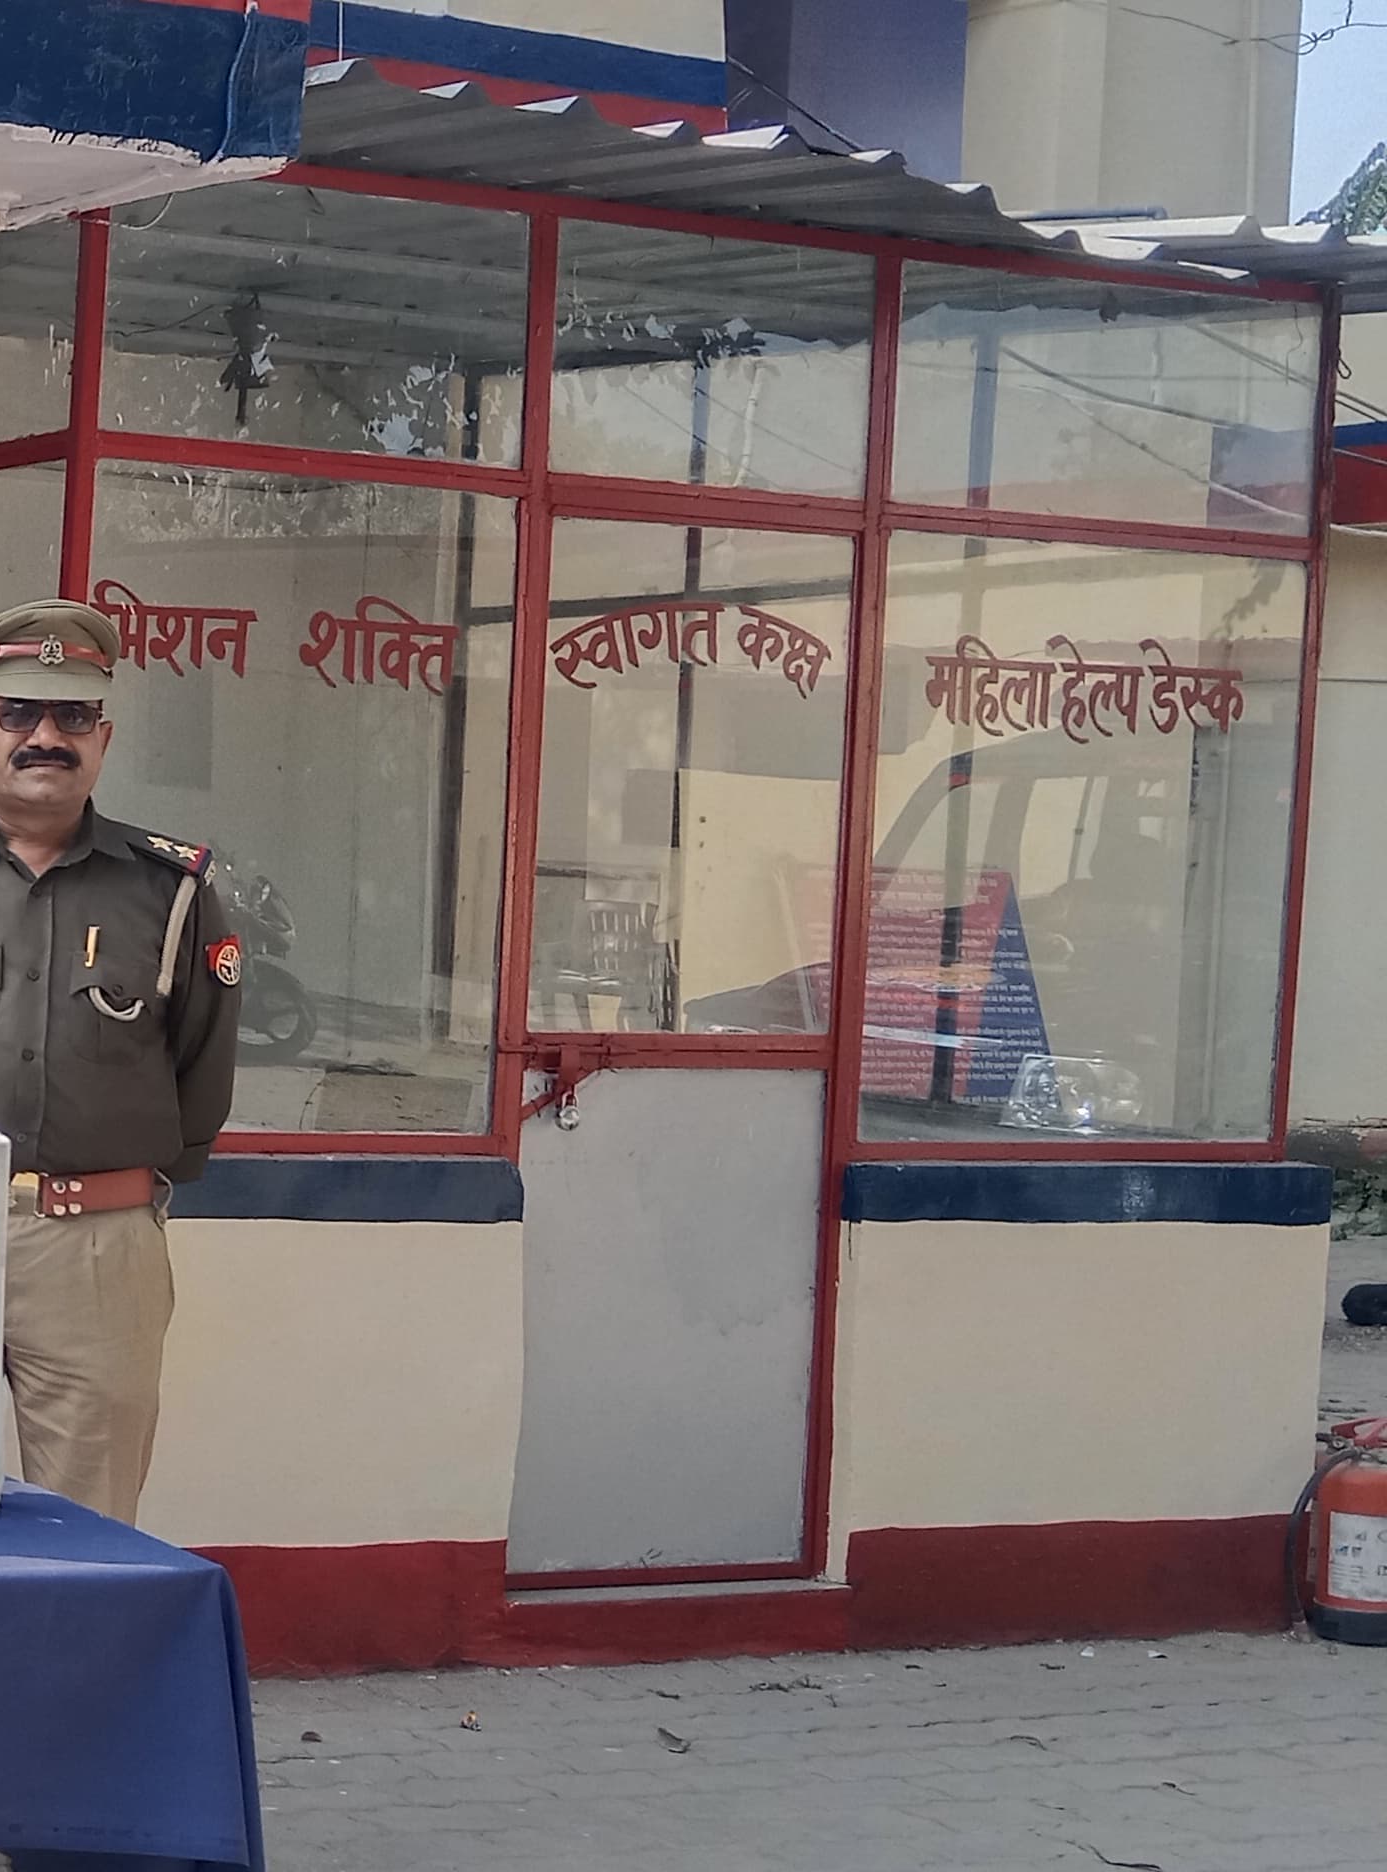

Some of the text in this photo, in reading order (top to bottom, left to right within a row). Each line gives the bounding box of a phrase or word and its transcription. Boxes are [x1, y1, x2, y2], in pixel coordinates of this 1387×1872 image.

[299, 595, 459, 696] शक्ति
[549, 602, 832, 699] स्वागत कक्ष
[925, 634, 1244, 744] महिला हेल्प डेस्क
